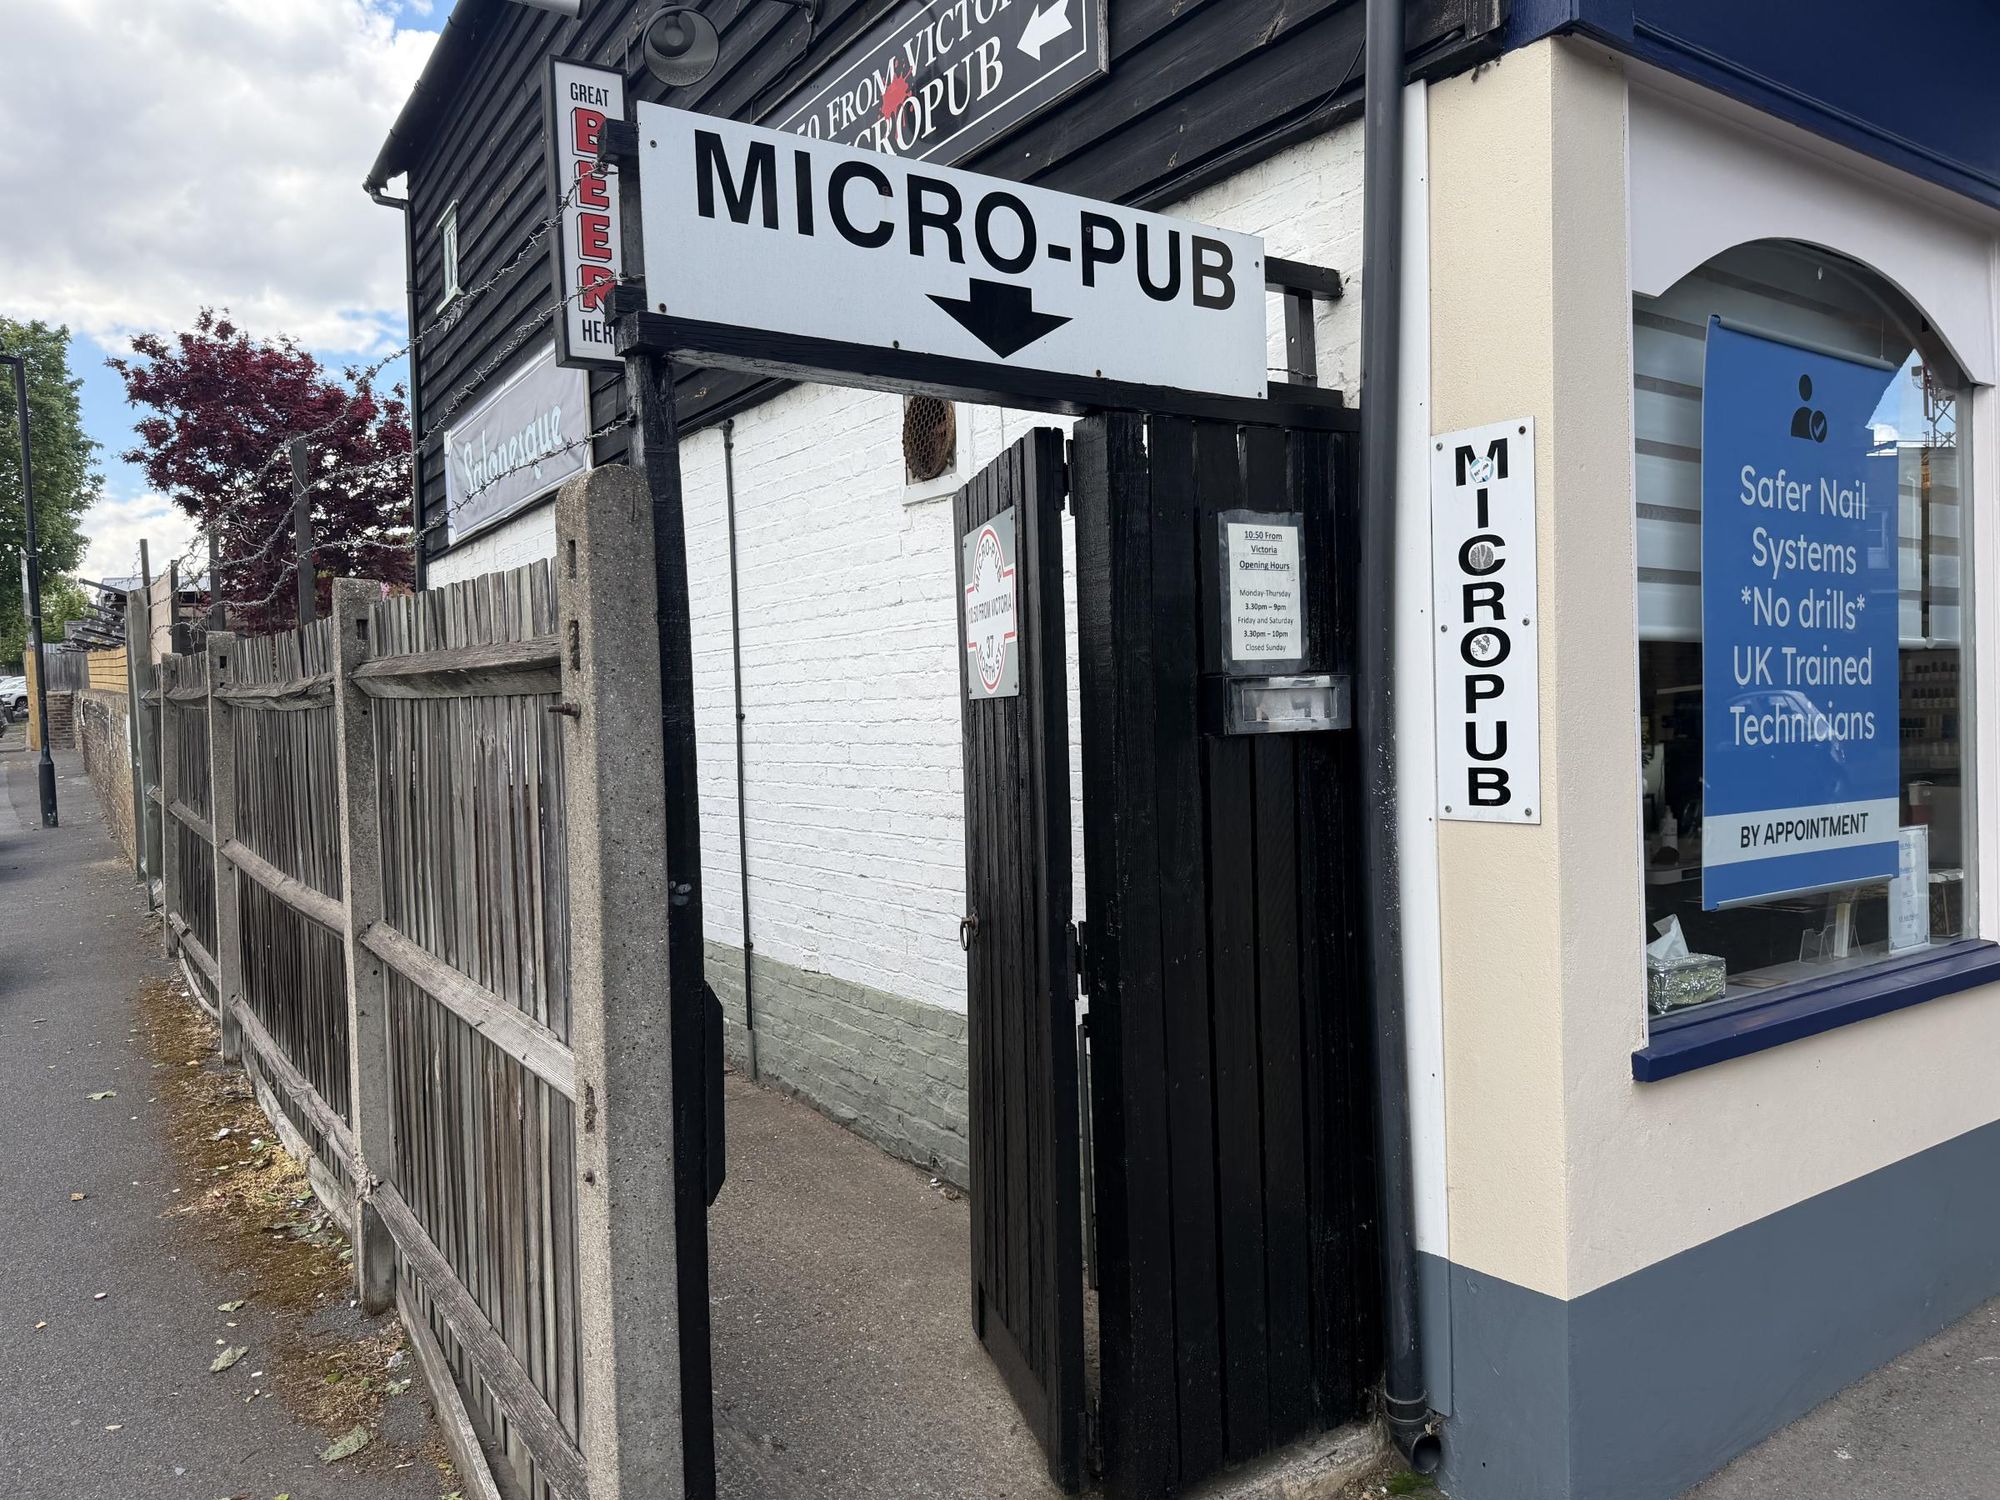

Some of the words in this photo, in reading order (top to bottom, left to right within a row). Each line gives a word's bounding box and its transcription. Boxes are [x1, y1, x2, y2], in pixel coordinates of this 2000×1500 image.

[827, 56, 896, 140] FROM
[903, 0, 1012, 76] VICTO
[570, 82, 609, 107] GREAT
[570, 107, 616, 313] BEER
[694, 129, 1235, 310] MICRO-PUB
[582, 319, 614, 344] HER
[1740, 465, 1812, 512] Safer
[1820, 477, 1866, 521] Nail
[1250, 544, 1278, 554] Victoria
[1264, 531, 1283, 541] From
[1239, 560, 1269, 571] Opening
[1270, 561, 1290, 571] Hours
[1752, 526, 1857, 580] Systems
[991, 591, 1013, 617] VICTORIA
[1245, 602, 1268, 611] 3.30pm
[1273, 603, 1287, 611] 9pm
[1237, 616, 1256, 625] Friday
[1269, 616, 1294, 625] Saturday
[1455, 438, 1512, 806] MICROPUB
[986, 634, 995, 660] 37
[1272, 630, 1289, 639] 10pm
[1265, 644, 1287, 653] Sunday
[979, 643, 996, 681] NORTH
[1733, 645, 1773, 686] UK
[1781, 644, 1873, 686] Trained
[1729, 700, 1876, 746] Technicians
[1740, 824, 1760, 849] BY
[1763, 812, 1869, 846] APPOINTMENT
